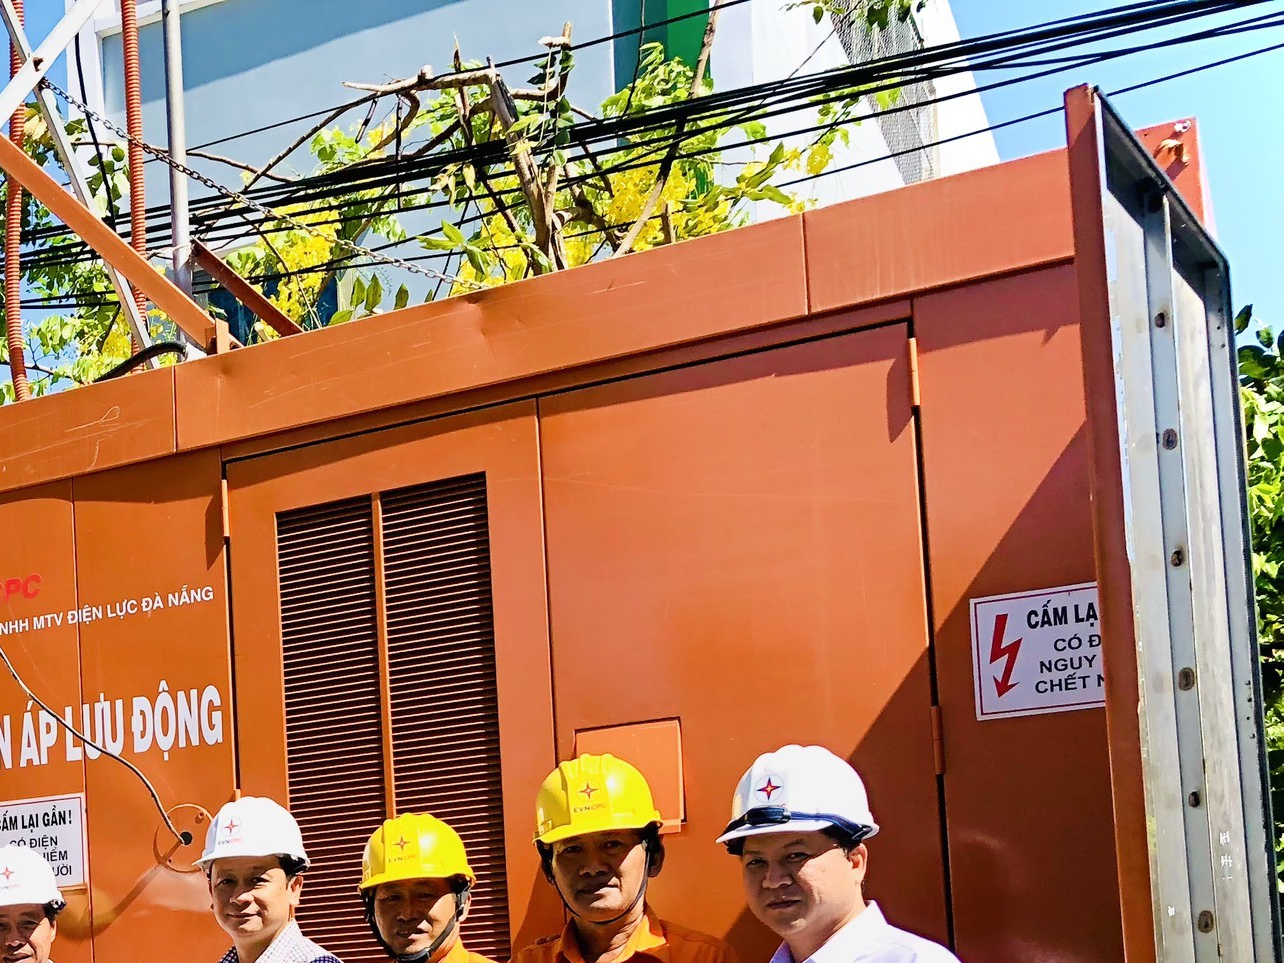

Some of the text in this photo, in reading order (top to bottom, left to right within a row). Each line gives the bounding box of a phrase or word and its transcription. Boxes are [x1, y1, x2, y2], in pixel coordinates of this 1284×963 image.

[33, 613, 64, 630] MTV
[67, 603, 103, 625] ĐIỆN
[107, 598, 137, 621] LỰC
[141, 591, 164, 612] ĐÀ
[168, 583, 214, 607] NẴNG
[1026, 599, 1098, 629] CẤM LẠ
[1053, 633, 1082, 652] CÓ
[1039, 654, 1097, 674] NGUY
[1035, 672, 1090, 694] CHẾT
[19, 700, 57, 768] ÁP
[65, 693, 124, 761] LƯU
[131, 680, 223, 761] ĐỘNG
[21, 813, 39, 833] LẠI
[29, 835, 58, 850] ĐIỆN
[42, 846, 68, 862] IỂM
[52, 863, 72, 877] ƯỜI
